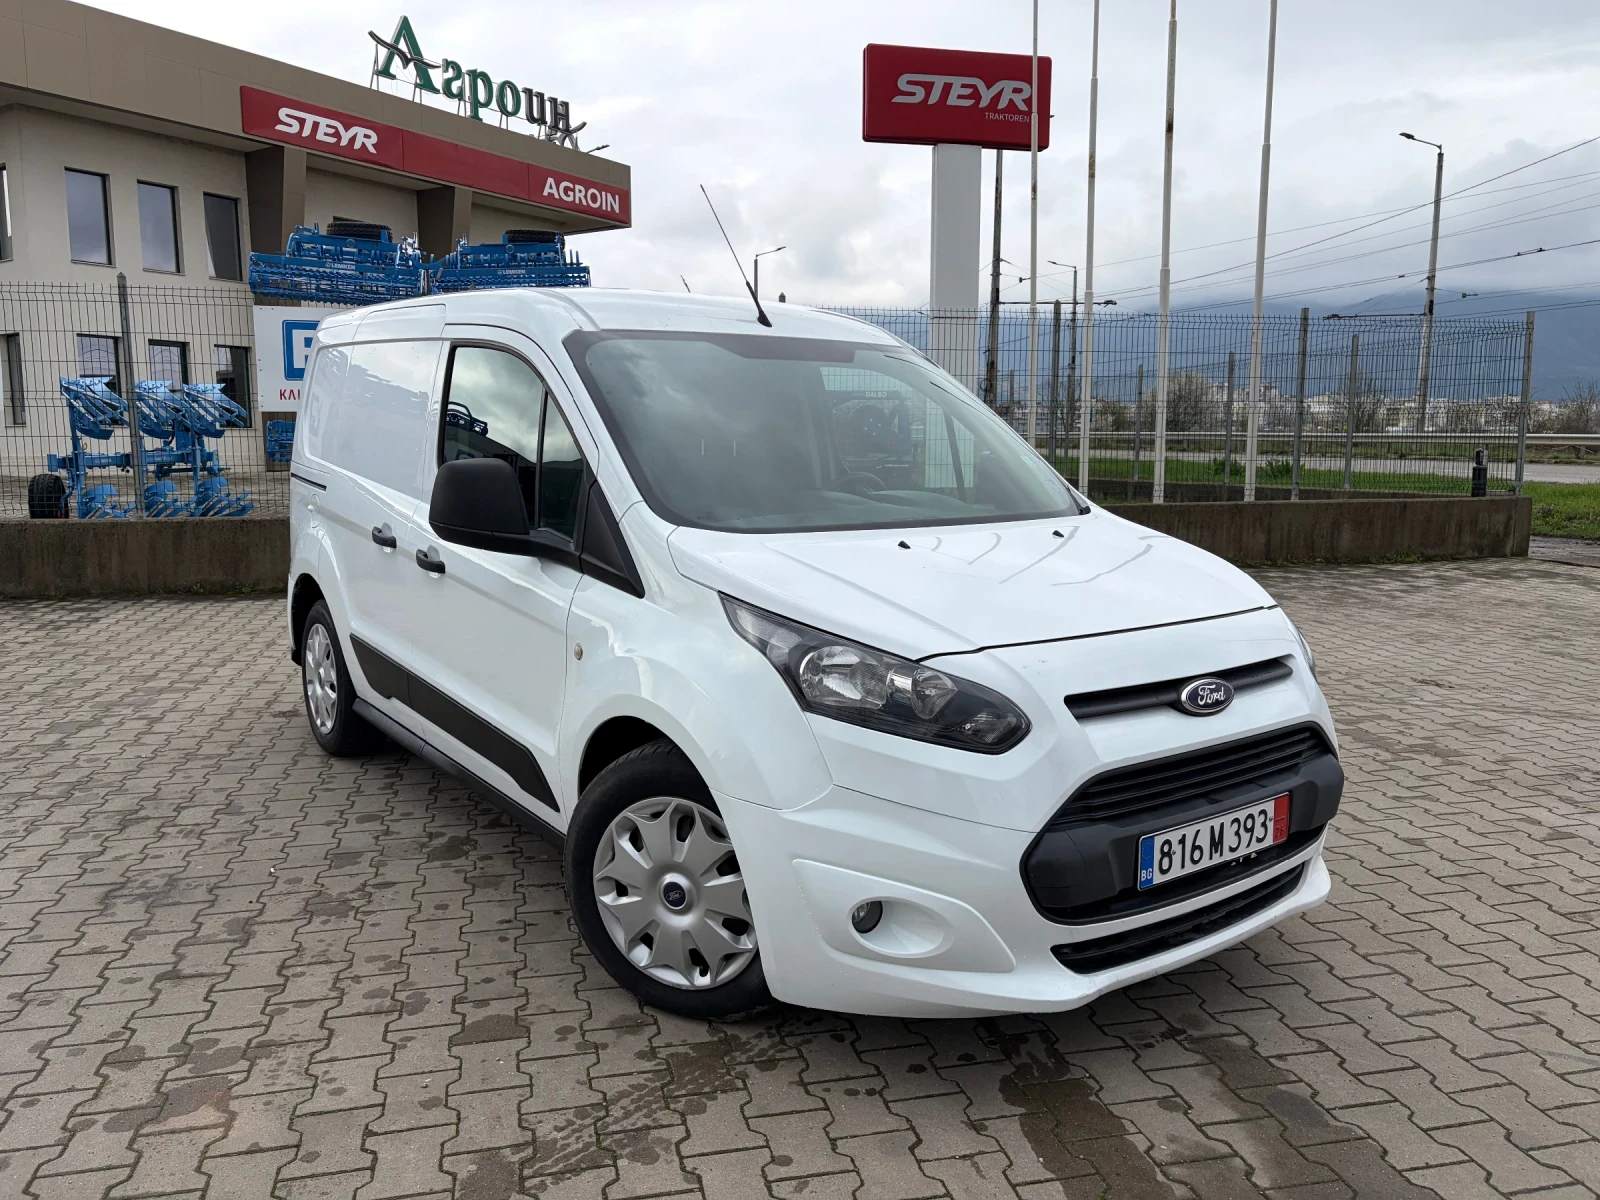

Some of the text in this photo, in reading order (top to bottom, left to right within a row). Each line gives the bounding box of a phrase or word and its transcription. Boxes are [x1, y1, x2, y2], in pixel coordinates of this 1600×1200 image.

[891, 73, 1032, 111] STEYR
[985, 112, 1030, 122] TRAKTOREN
[274, 107, 378, 154] STEYR
[542, 176, 620, 214] AGROIN
[331, 262, 356, 270] LEMKEN
[1197, 684, 1225, 705] Ford
[1140, 867, 1153, 881] BG
